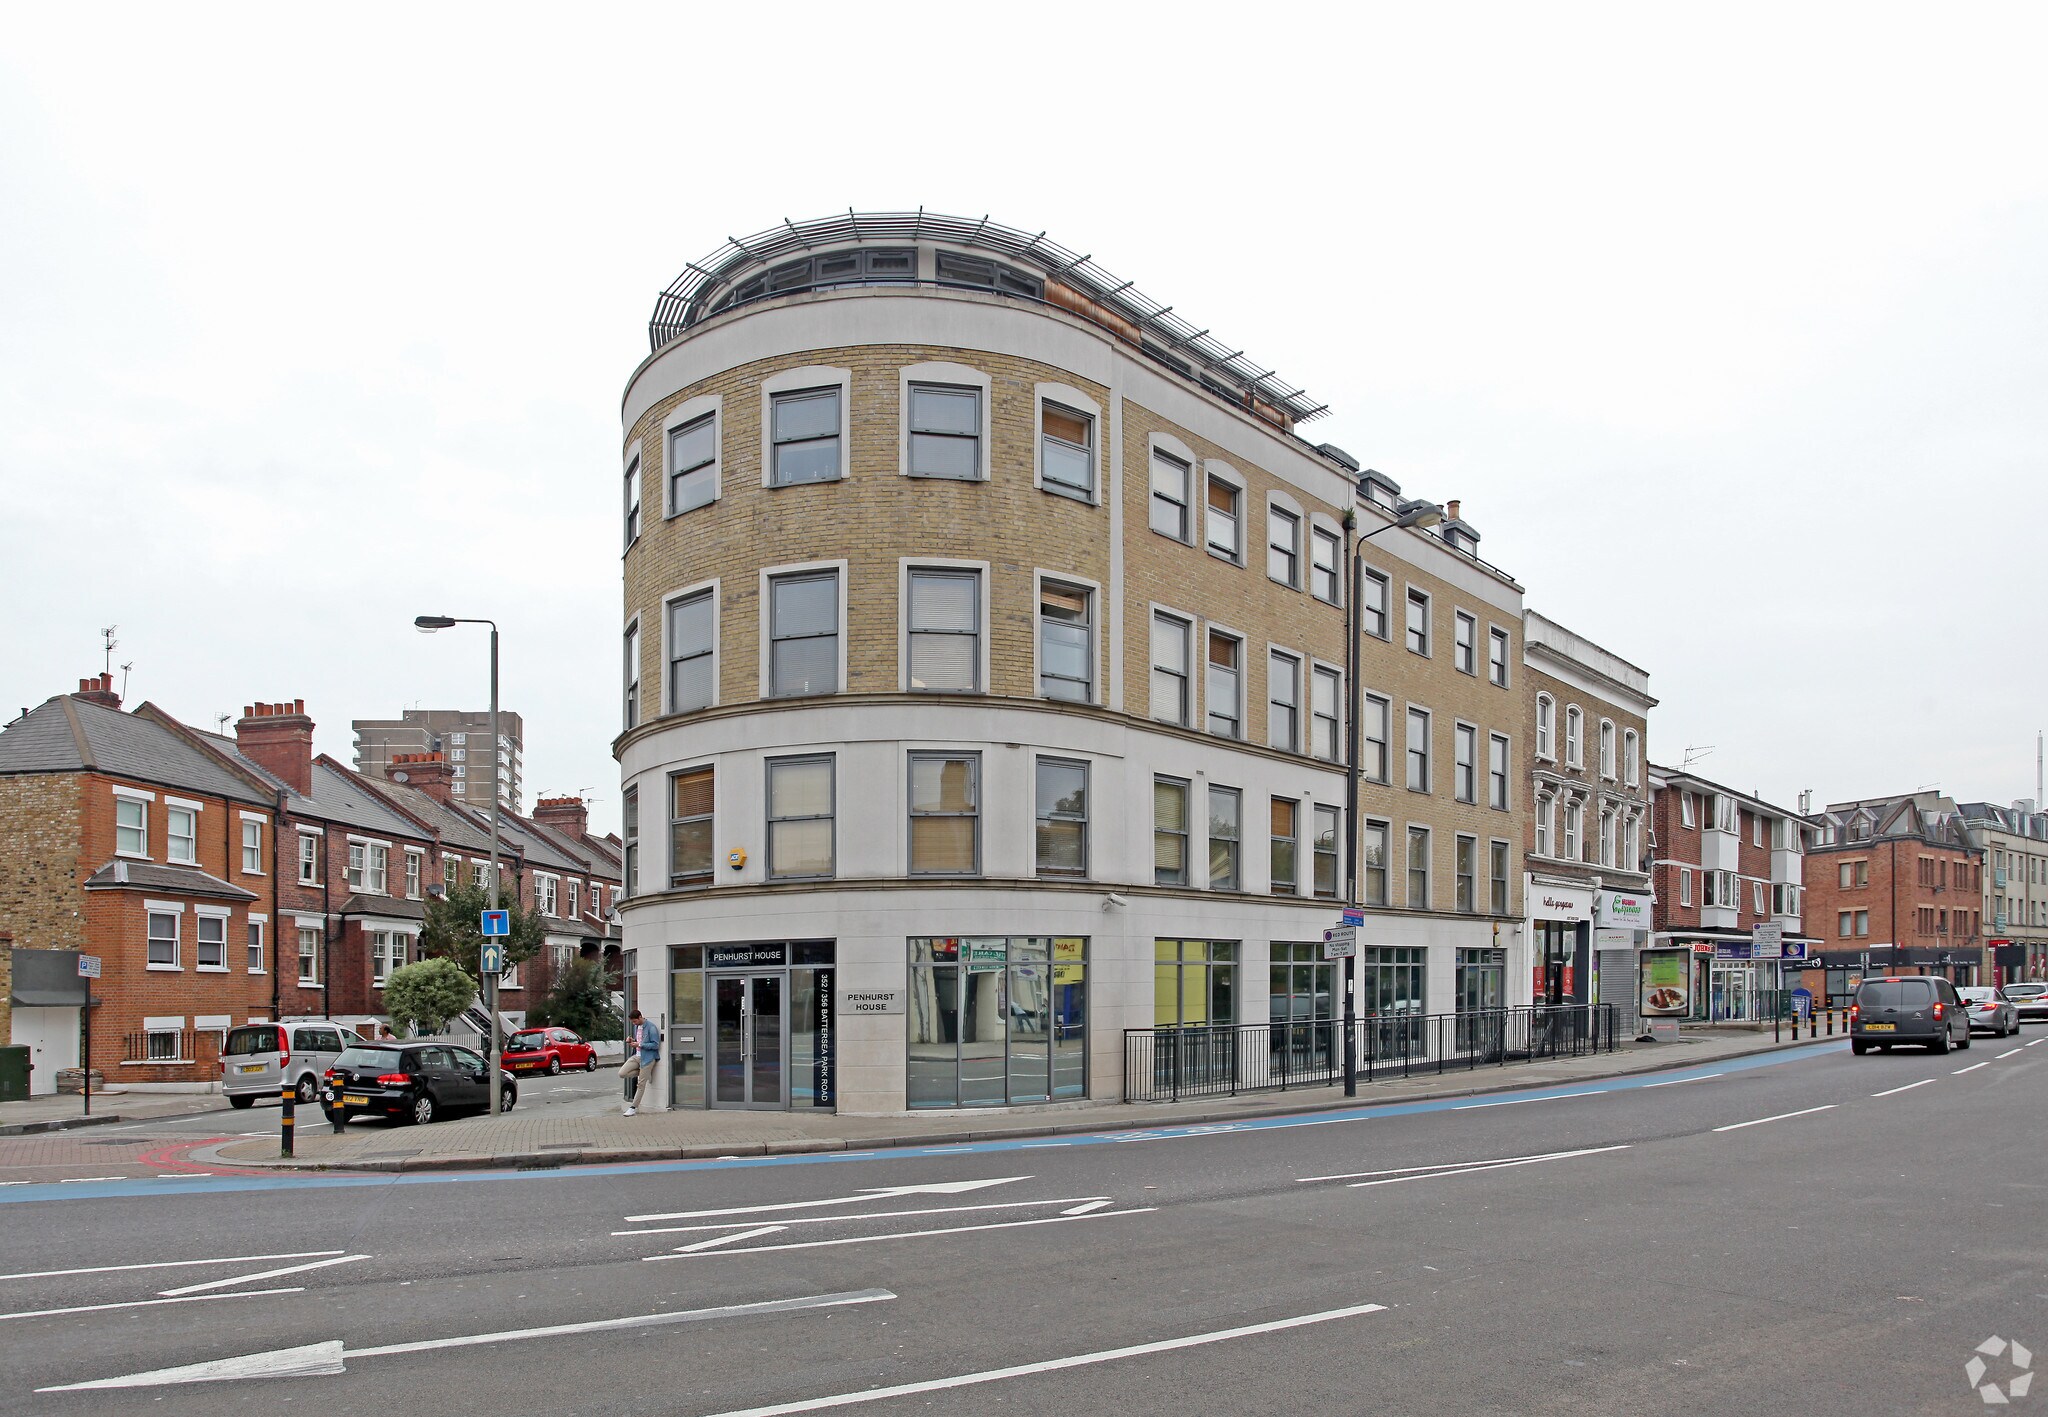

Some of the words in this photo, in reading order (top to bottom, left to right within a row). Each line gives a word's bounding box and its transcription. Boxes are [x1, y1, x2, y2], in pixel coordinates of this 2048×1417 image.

[714, 952, 753, 962] PENHURST
[754, 951, 781, 960] HOUSE
[856, 1003, 887, 1011] HOUSE
